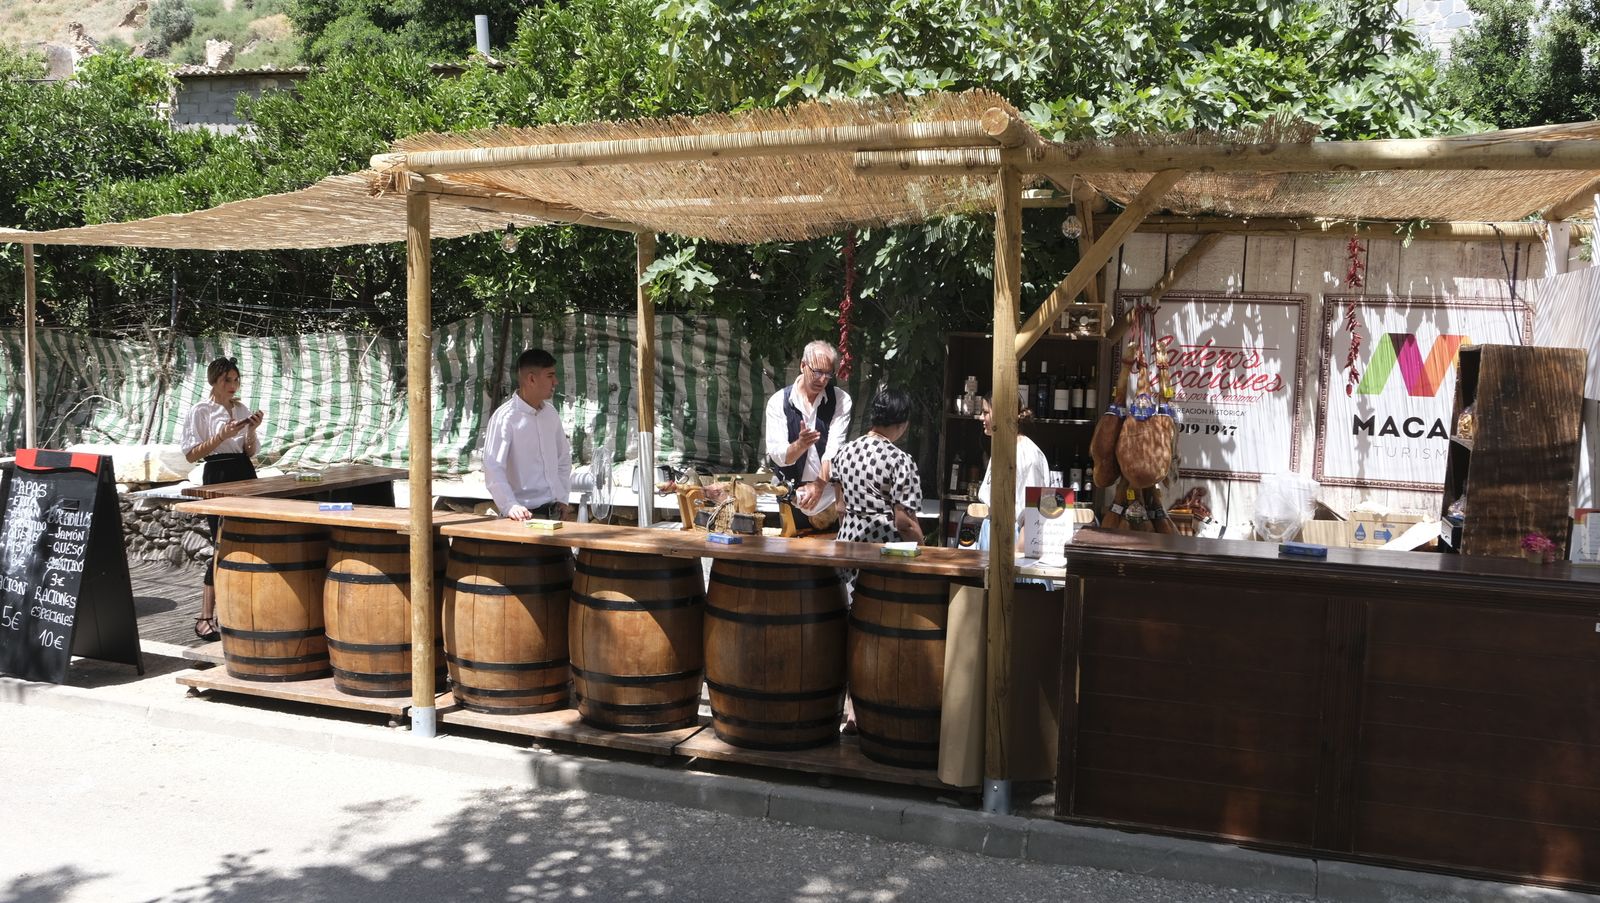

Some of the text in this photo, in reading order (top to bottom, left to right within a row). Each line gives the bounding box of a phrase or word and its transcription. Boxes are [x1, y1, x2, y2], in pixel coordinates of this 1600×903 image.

[1178, 423, 1238, 436] 919 1947
[1352, 414, 1449, 440] MACA
[1373, 445, 1447, 460] TURISM
[11, 477, 47, 498] TAPAS
[53, 542, 85, 555] QUESO
[0, 574, 28, 595] ACIÓN
[34, 586, 76, 609] RACIONES
[1, 605, 22, 630] 5€
[38, 629, 64, 650] 10€
